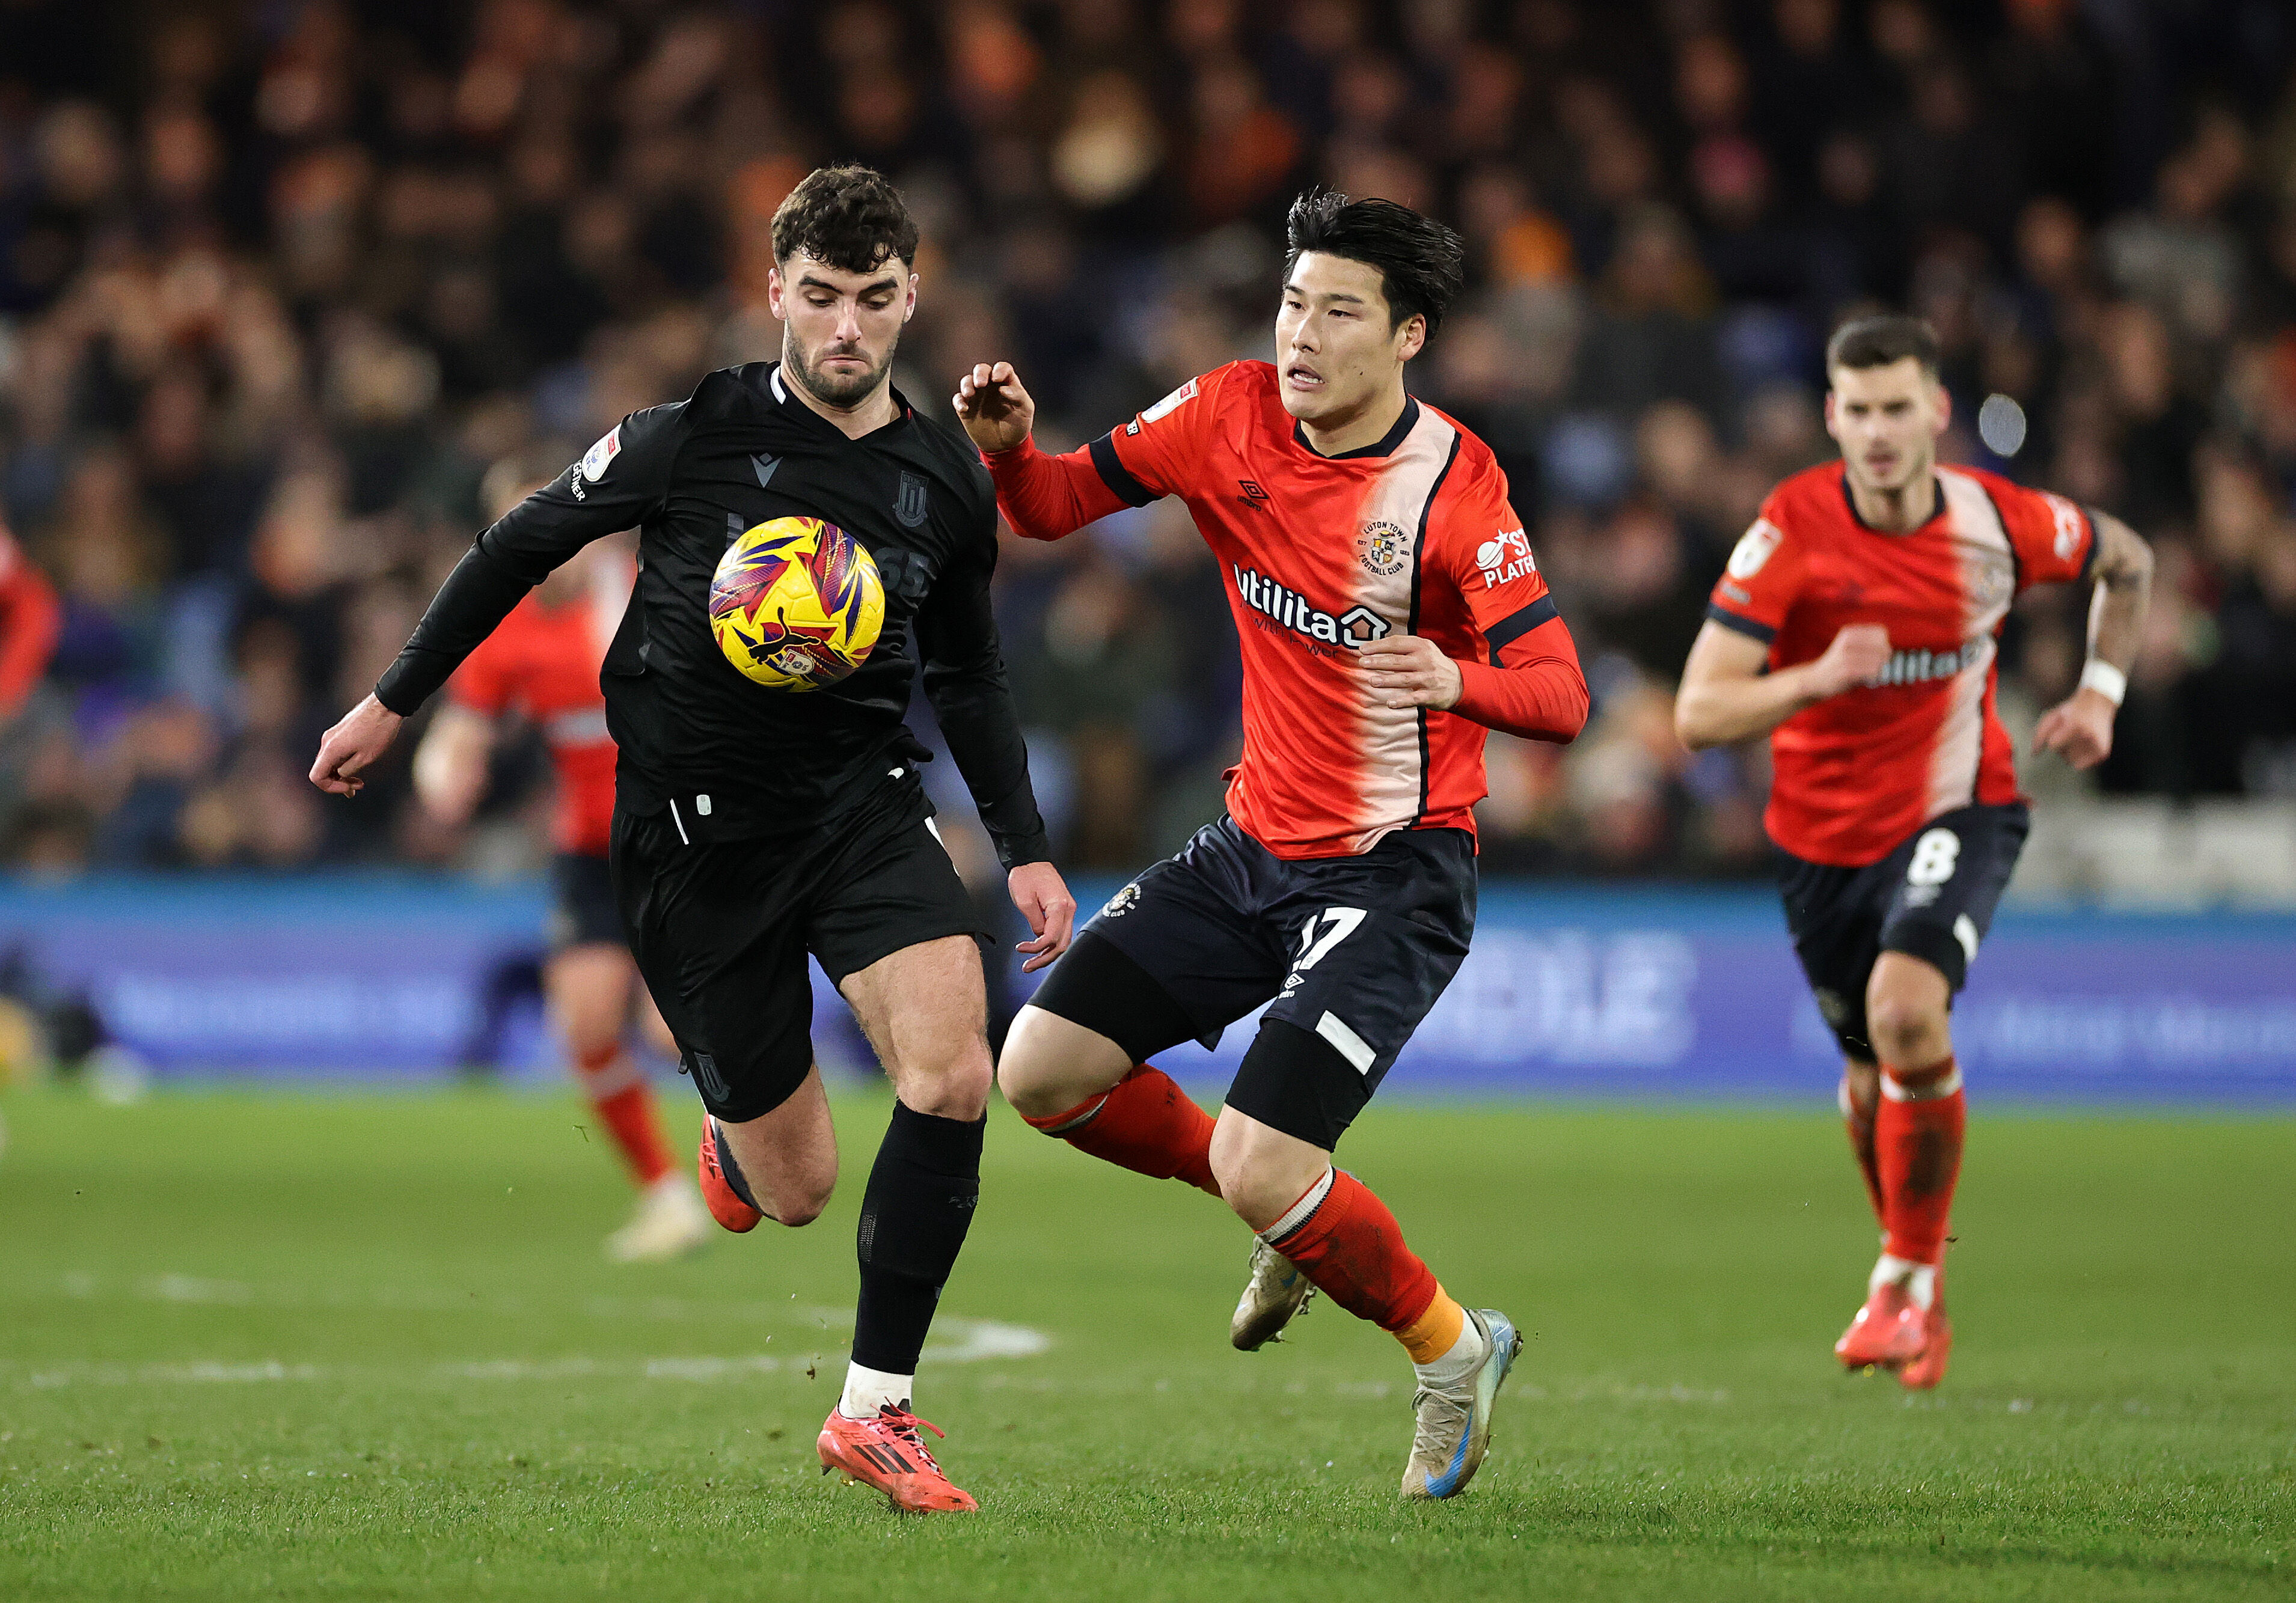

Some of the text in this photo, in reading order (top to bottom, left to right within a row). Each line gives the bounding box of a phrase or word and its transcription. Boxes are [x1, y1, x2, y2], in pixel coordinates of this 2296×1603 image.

[1237, 495, 1261, 511] umbro
[1363, 521, 1408, 542] LUTON TOWN
[1359, 554, 1404, 575] FOOTBALL CLUB
[1234, 563, 1338, 644] utilita
[1906, 826, 1961, 886] 8
[1292, 906, 1368, 972] 17
